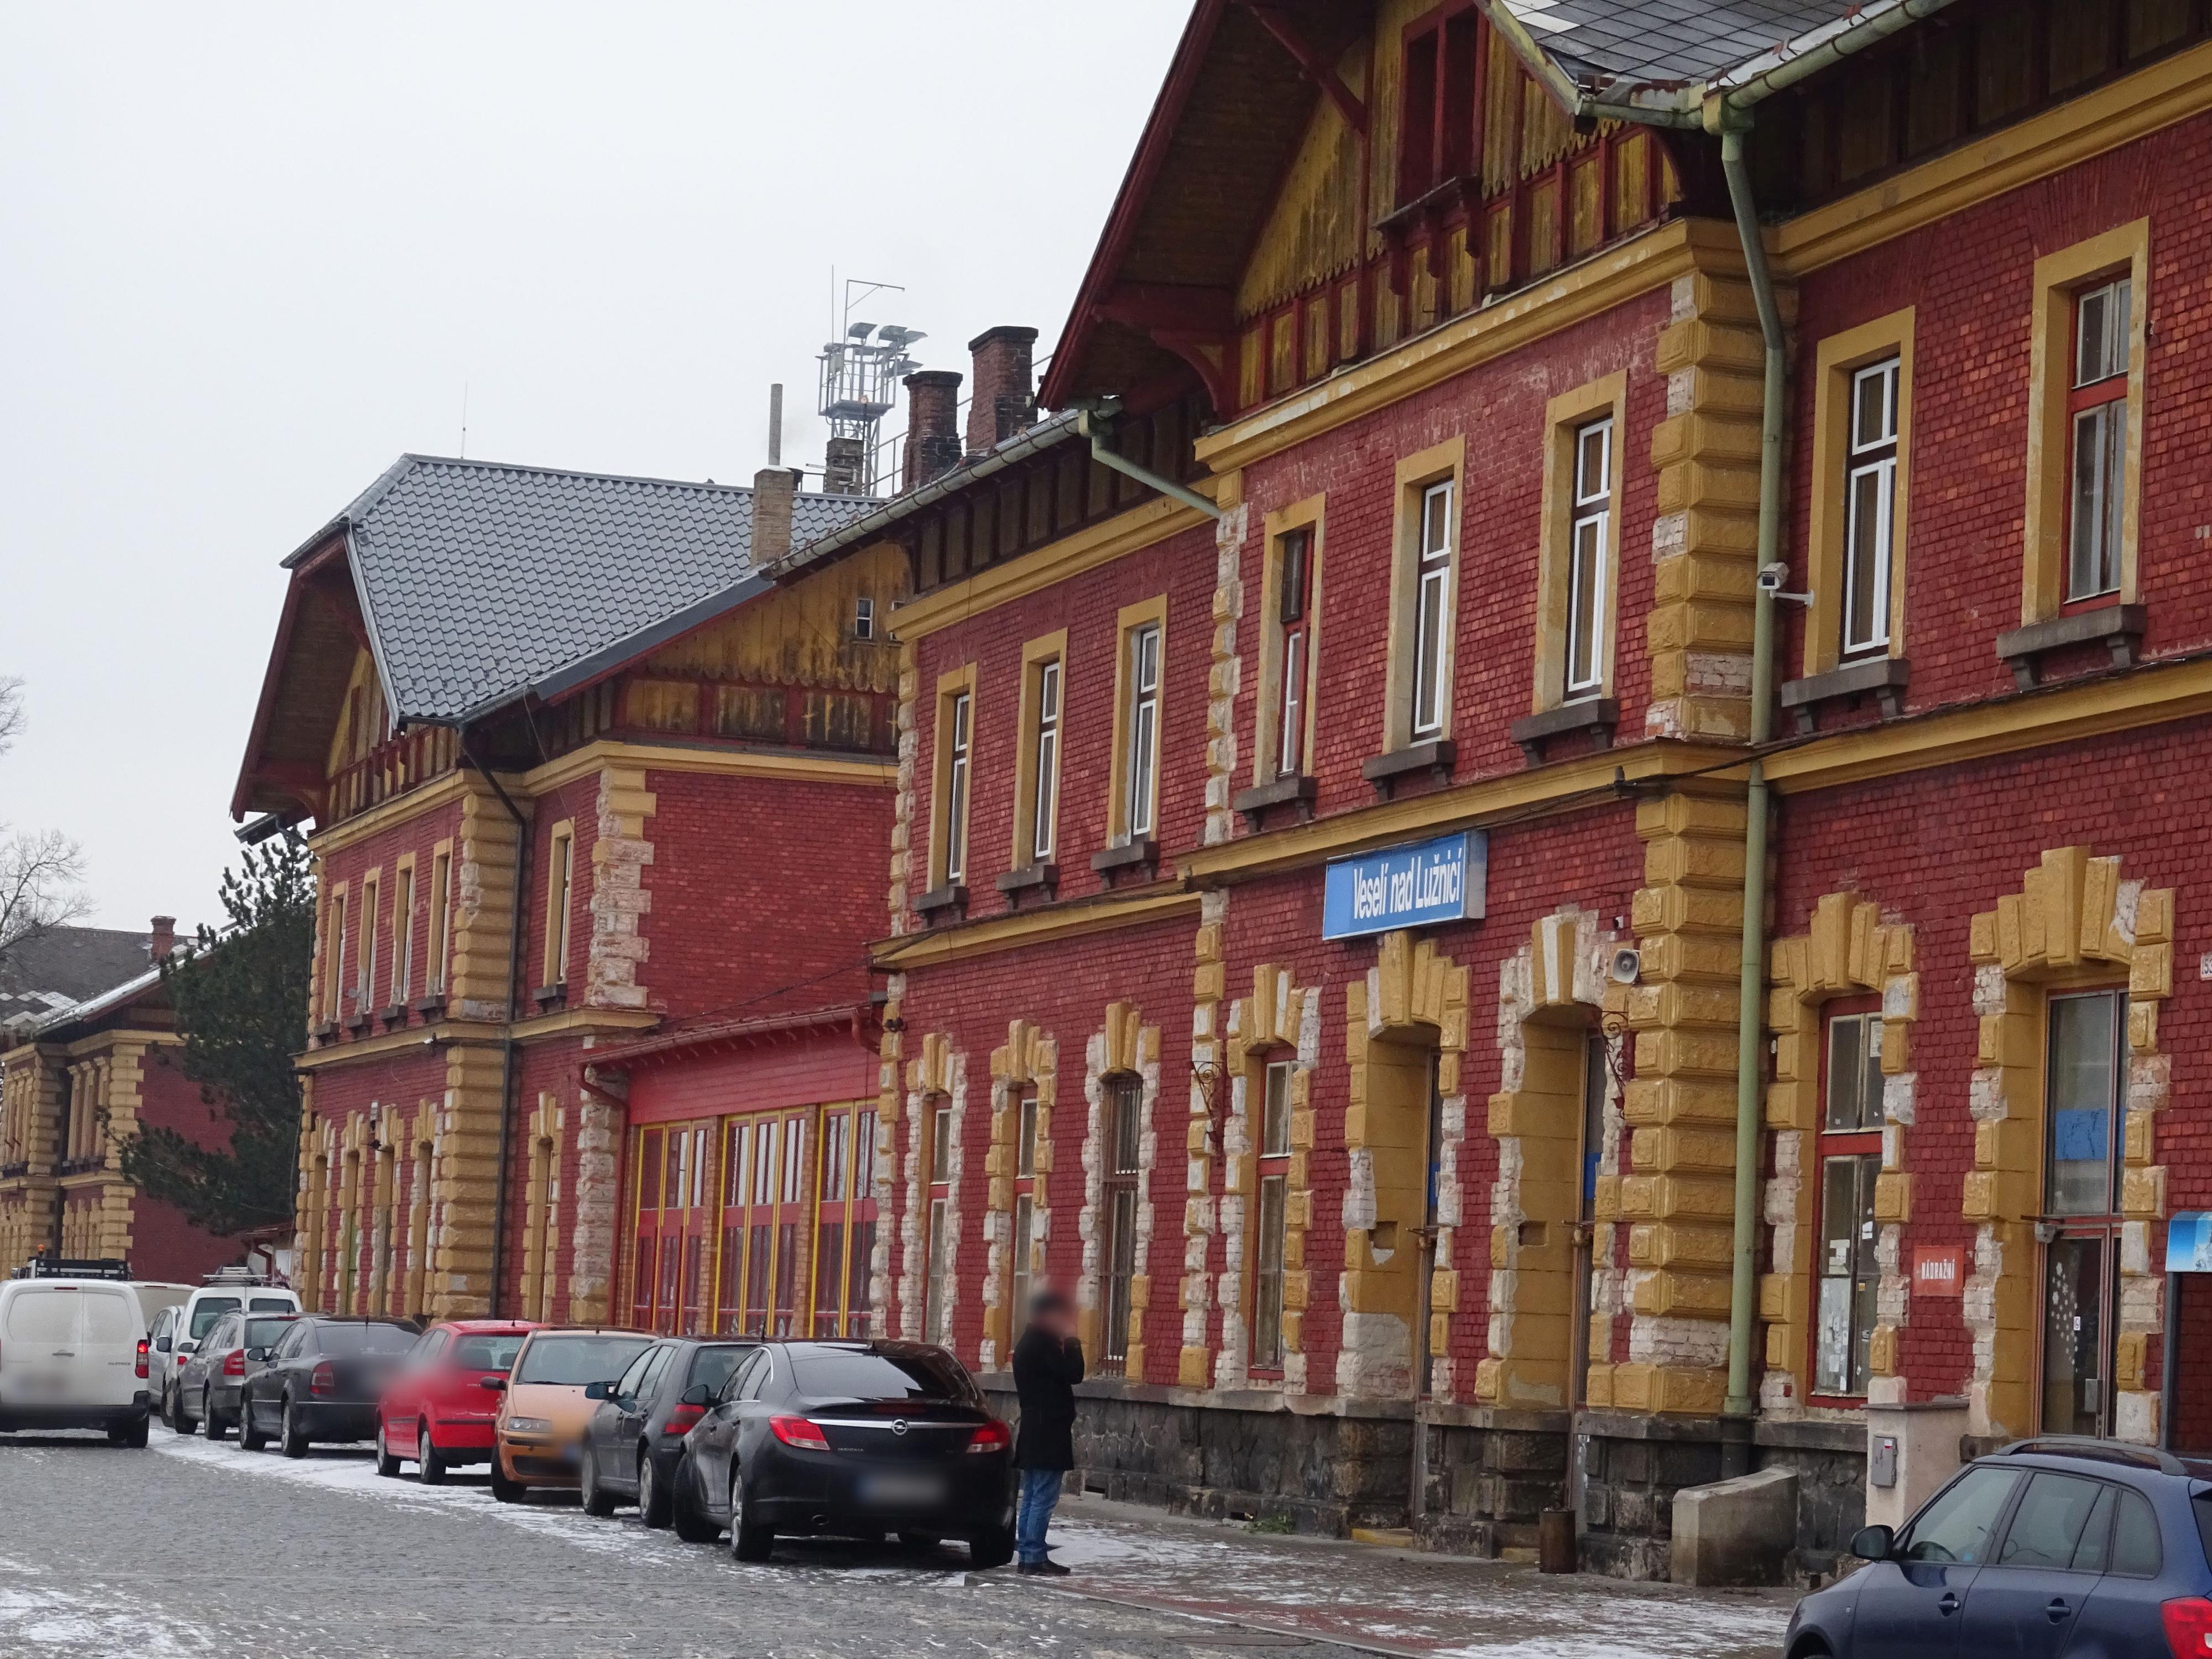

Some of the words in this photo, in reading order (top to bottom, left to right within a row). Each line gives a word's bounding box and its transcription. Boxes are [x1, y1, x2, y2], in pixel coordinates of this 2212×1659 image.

[1354, 862, 1389, 919] Veselí
[1390, 857, 1415, 914] nad
[1415, 847, 1462, 909] Lužnicí
[1921, 1258, 1955, 1280] NÁDRAŽNÍ
